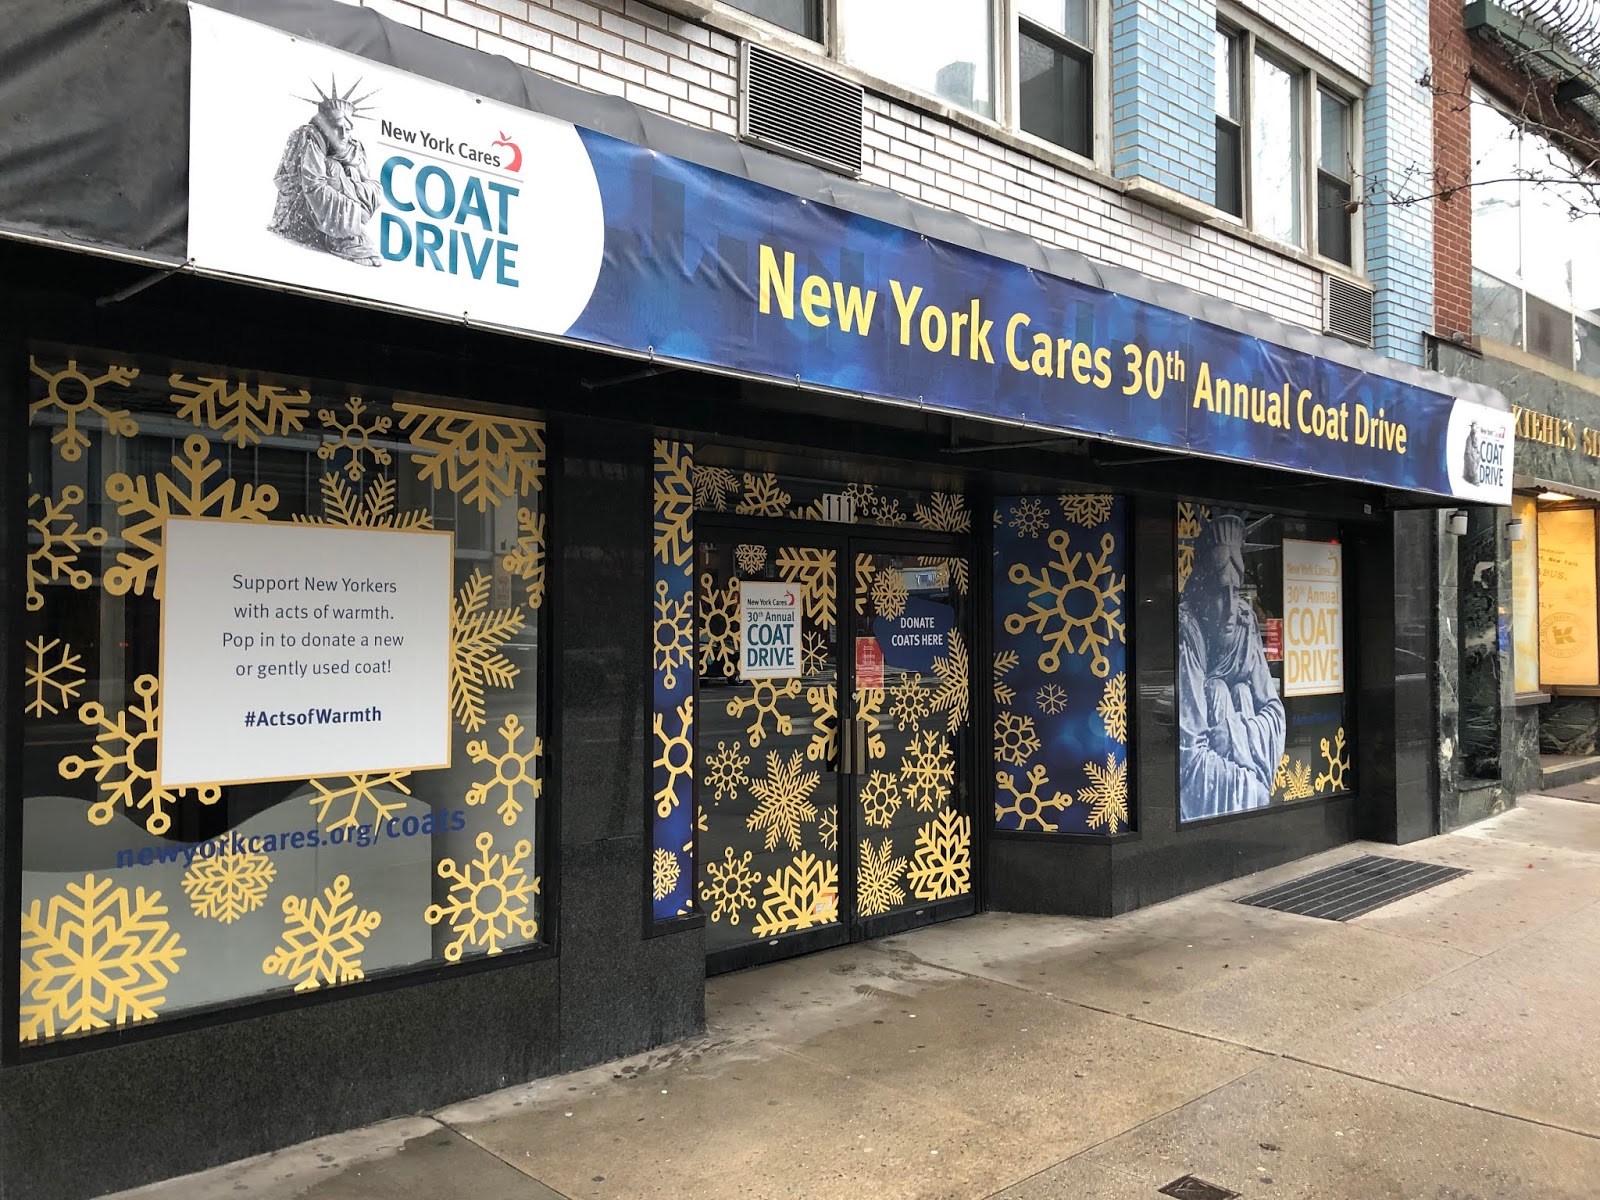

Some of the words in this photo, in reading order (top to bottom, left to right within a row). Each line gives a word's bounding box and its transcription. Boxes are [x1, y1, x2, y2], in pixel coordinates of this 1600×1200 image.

[381, 119, 417, 144] New
[420, 130, 455, 156] York
[458, 142, 501, 168] Cares
[379, 155, 520, 235] COAT
[379, 211, 519, 288] DRIVE
[759, 244, 877, 337] New
[889, 279, 995, 365] York
[1005, 312, 1112, 389] Cares
[1122, 343, 1186, 400] 30th
[1192, 361, 1291, 430] Annual
[1297, 389, 1349, 442] Coat
[1355, 403, 1407, 454] Drive
[1511, 404, 1577, 451] KIEHL'S
[1583, 427, 1600, 458] SI
[1480, 440, 1505, 466] COAT
[1479, 464, 1504, 487] DRIVE
[825, 494, 852, 523] 111
[232, 573, 300, 594] Support
[304, 576, 338, 592] New
[342, 577, 398, 593] Yorkers
[1539, 567, 1568, 581] BUS.
[747, 598, 760, 606] New
[760, 598, 772, 606] York
[1307, 585, 1340, 604] Annual
[234, 602, 269, 619] with
[275, 605, 309, 619] acts
[313, 604, 330, 619] of
[332, 605, 395, 620] warmth.
[747, 611, 764, 622] 30th
[765, 611, 795, 622] Annual
[900, 617, 935, 629] DONATE
[1287, 607, 1339, 646] COAT
[222, 632, 254, 651] Pop
[260, 632, 275, 647] in
[280, 634, 296, 647] to
[301, 632, 356, 648] donate
[360, 634, 369, 647] a
[374, 634, 404, 647] new
[747, 623, 794, 646] COAT
[891, 634, 920, 647] COATS
[921, 634, 944, 646] HERE
[747, 647, 795, 667] DRIVE
[1287, 649, 1340, 684] DRIVE
[235, 662, 253, 676] or
[257, 660, 308, 679] gently
[312, 660, 350, 675] used
[354, 659, 392, 674] coat!
[244, 706, 382, 728] #ActsofWarmth
[115, 807, 466, 869] newyorkcares.org/coats
